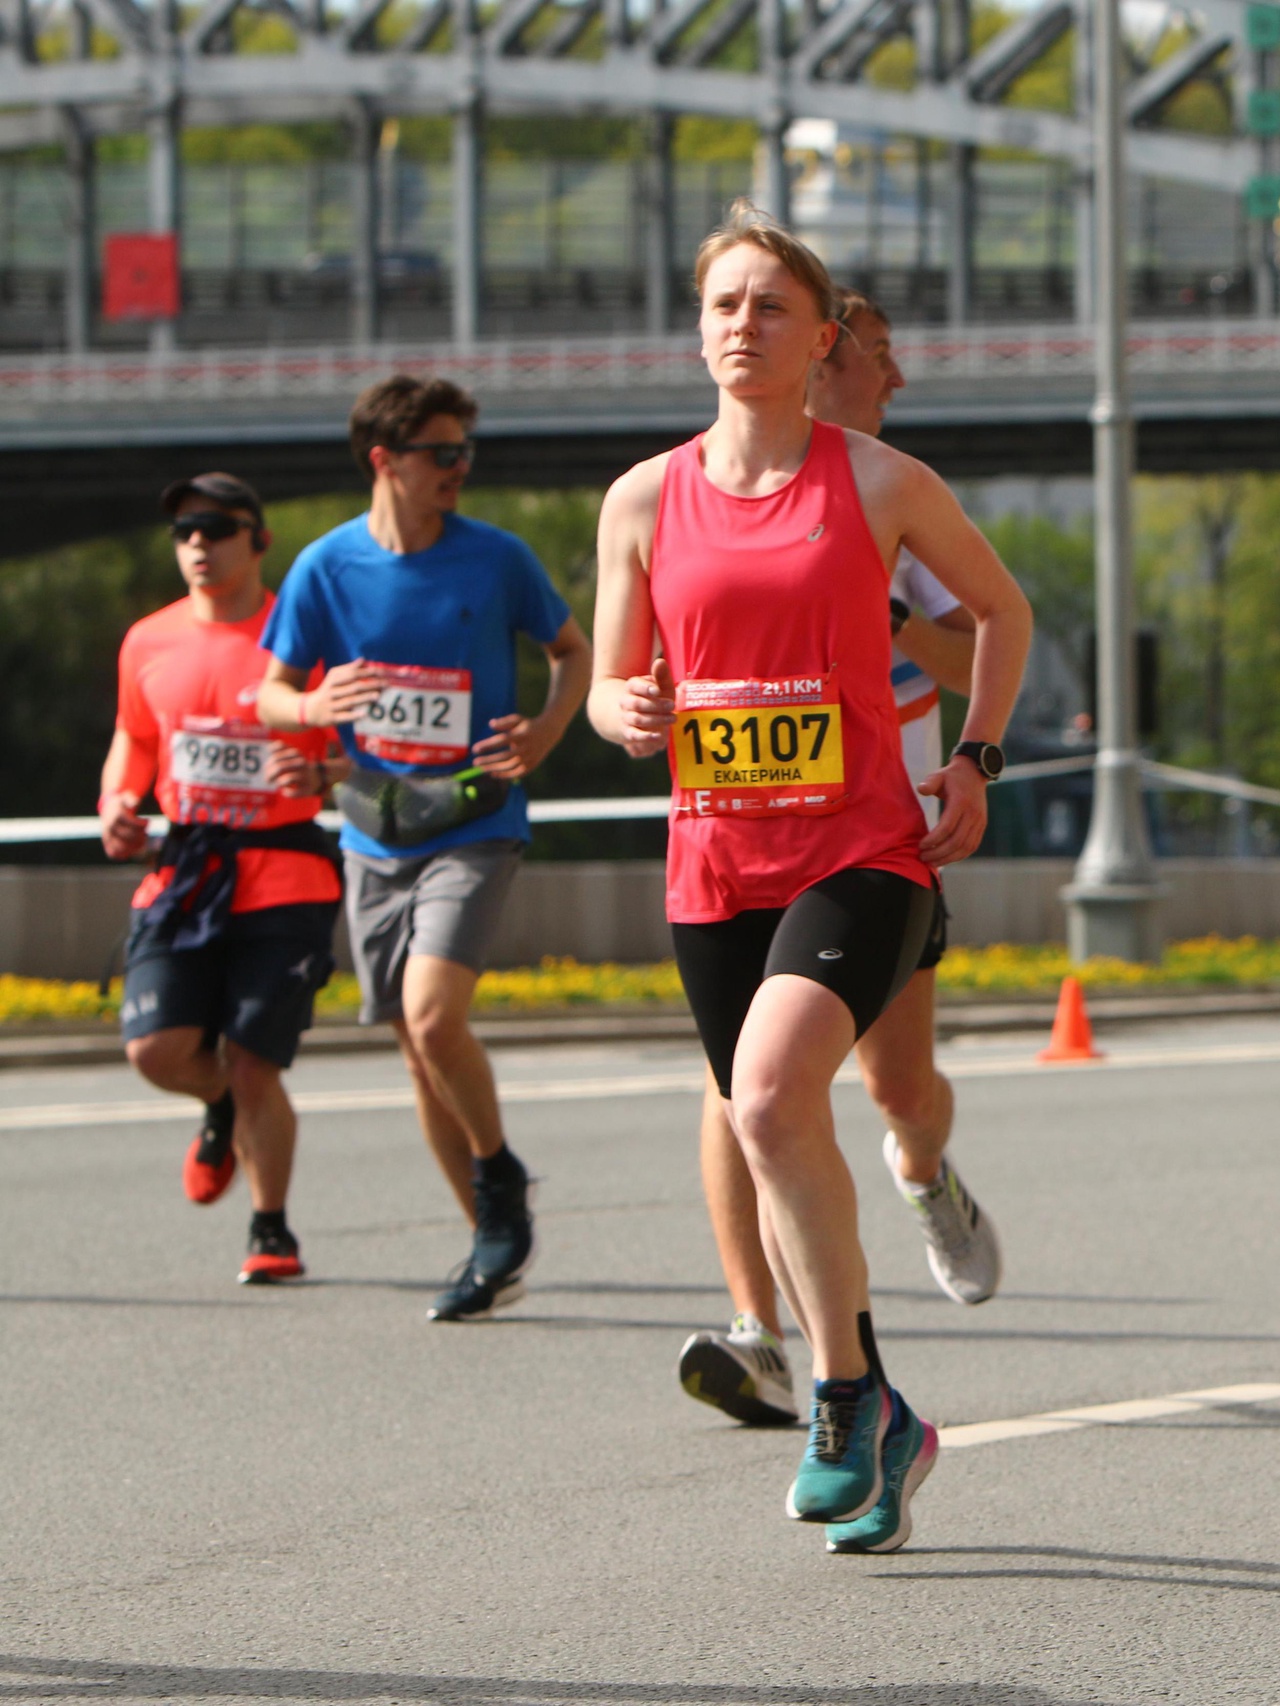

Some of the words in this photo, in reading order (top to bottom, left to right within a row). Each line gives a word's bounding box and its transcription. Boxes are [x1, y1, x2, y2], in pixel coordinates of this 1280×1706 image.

[762, 681, 791, 696] 21,1
[794, 678, 823, 694] КМ
[367, 694, 451, 729] 6612
[683, 713, 830, 765] 13107
[185, 738, 262, 775] 9985
[714, 768, 803, 784] ЕКАТЕРИНА
[695, 789, 714, 816] E
